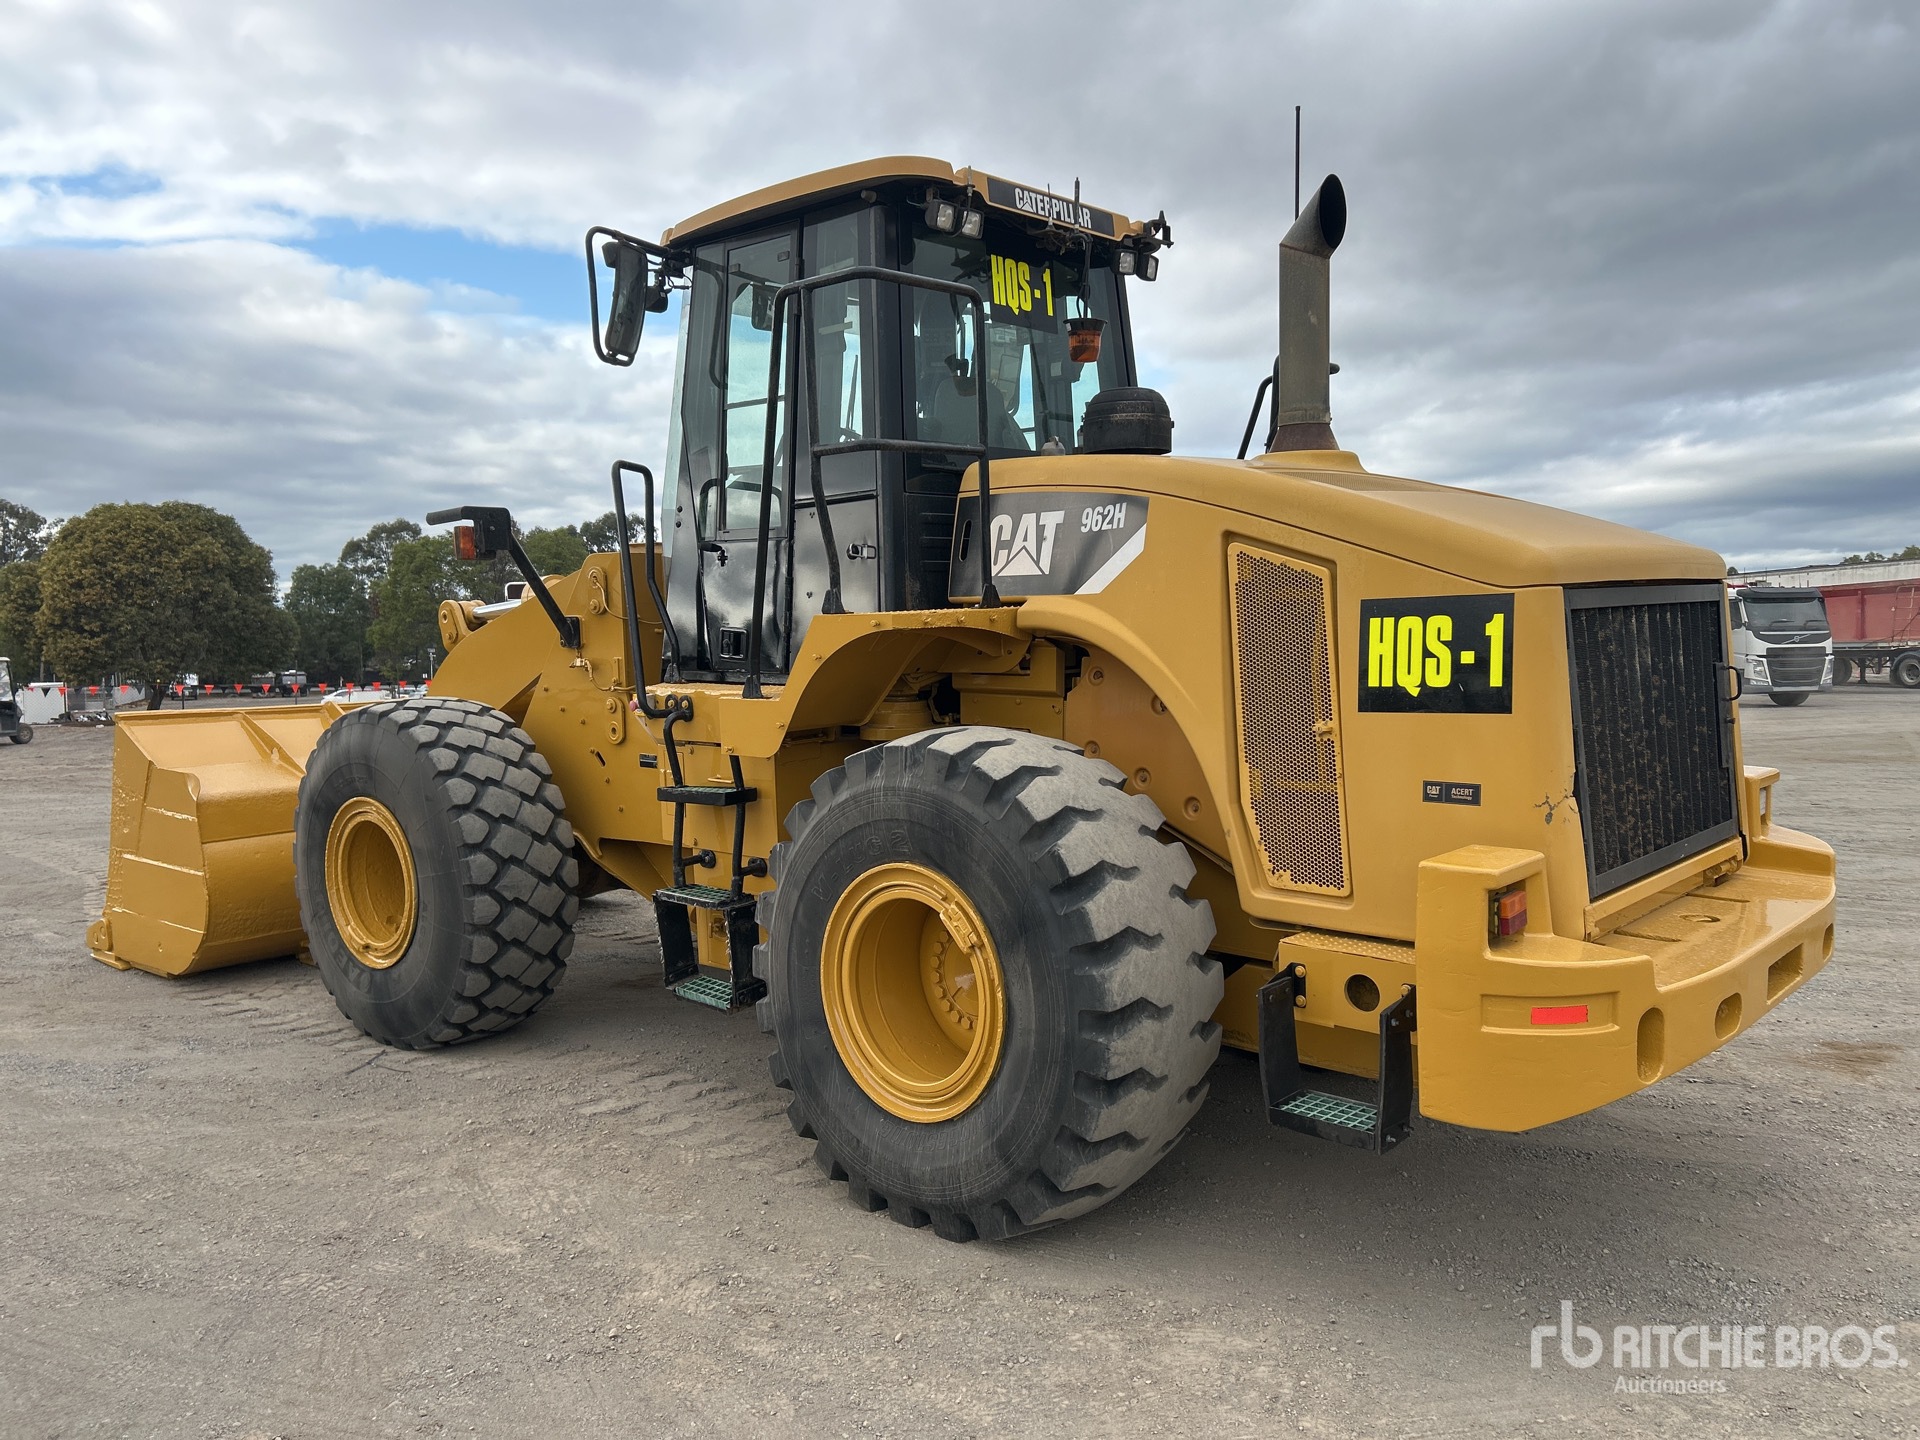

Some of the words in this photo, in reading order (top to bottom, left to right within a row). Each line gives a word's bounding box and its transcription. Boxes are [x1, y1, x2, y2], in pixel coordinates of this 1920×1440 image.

[1014, 187, 1092, 229] CATERPILLAR
[990, 510, 1065, 576] CAT
[1080, 502, 1127, 534] 962H
[1426, 785, 1441, 794] CAT
[1451, 787, 1473, 796] ACERT
